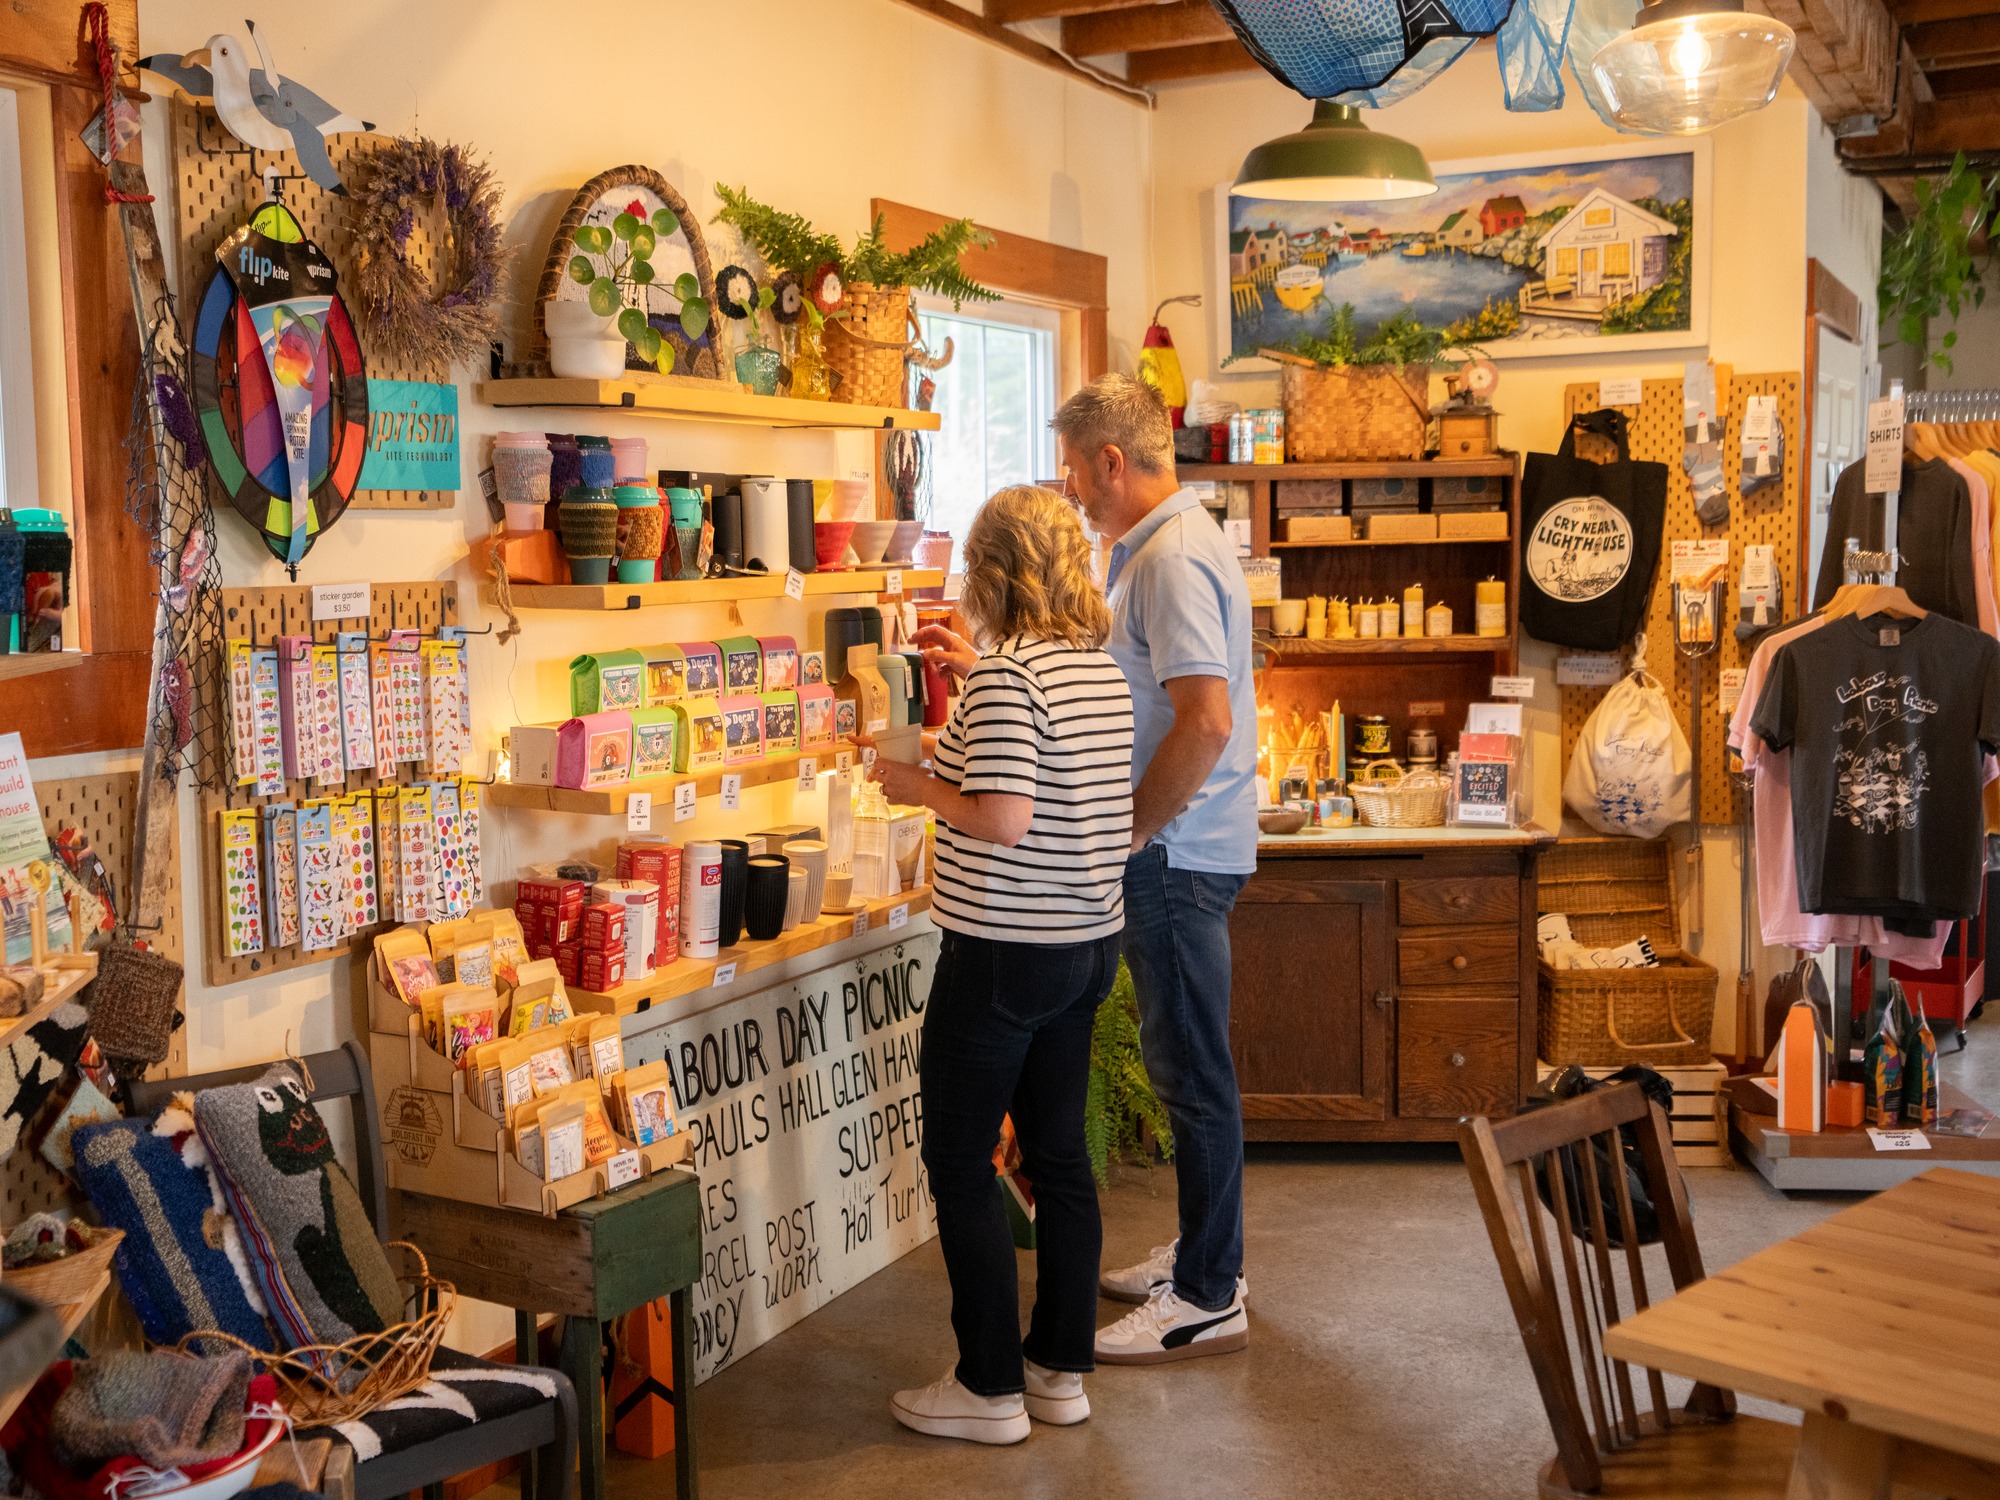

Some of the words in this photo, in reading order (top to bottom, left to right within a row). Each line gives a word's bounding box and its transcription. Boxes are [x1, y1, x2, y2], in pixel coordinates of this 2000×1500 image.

[273, 265, 289, 281] kite
[312, 264, 331, 279] prism
[285, 412, 307, 425] AMAZING
[375, 400, 455, 452] prism
[289, 435, 306, 447] ROTOR
[1870, 427, 1901, 443] SHIRTS
[293, 447, 305, 460] KITE
[386, 451, 402, 461] KITE
[407, 451, 453, 462] TECHNOLOGY
[1553, 515, 1580, 532] CRY
[1581, 520, 1610, 535] NEAR
[1611, 519, 1619, 533] A
[1538, 526, 1626, 551] LIGHTHOUSE
[320, 591, 340, 601] sticker
[341, 590, 365, 602] garden
[334, 604, 351, 612] $3.50
[692, 656, 713, 669] Decaf
[1836, 671, 1887, 704] Labour
[1866, 695, 1899, 716] Day
[1903, 685, 1939, 714] Picnic
[732, 710, 755, 723] Decaf
[1470, 782, 1500, 791] EXCITED
[898, 824, 920, 838] CHEMEX
[668, 870, 680, 879] YOUR
[434, 911, 461, 923] STORE
[640, 1019, 770, 1110] ABOUR
[776, 991, 829, 1069] DAY
[842, 946, 926, 1043] PICNIC
[688, 1094, 770, 1172] PAULS
[779, 1070, 830, 1134] HALL
[832, 1047, 878, 1109] GLEN
[883, 1026, 923, 1087] HAV
[391, 1129, 423, 1143] HOLDFAST
[425, 1135, 437, 1145] INK
[613, 1160, 628, 1168] NOVEL
[766, 1200, 815, 1265] POST
[458, 1248, 510, 1270] PRODUCT
[519, 1259, 533, 1274] OF
